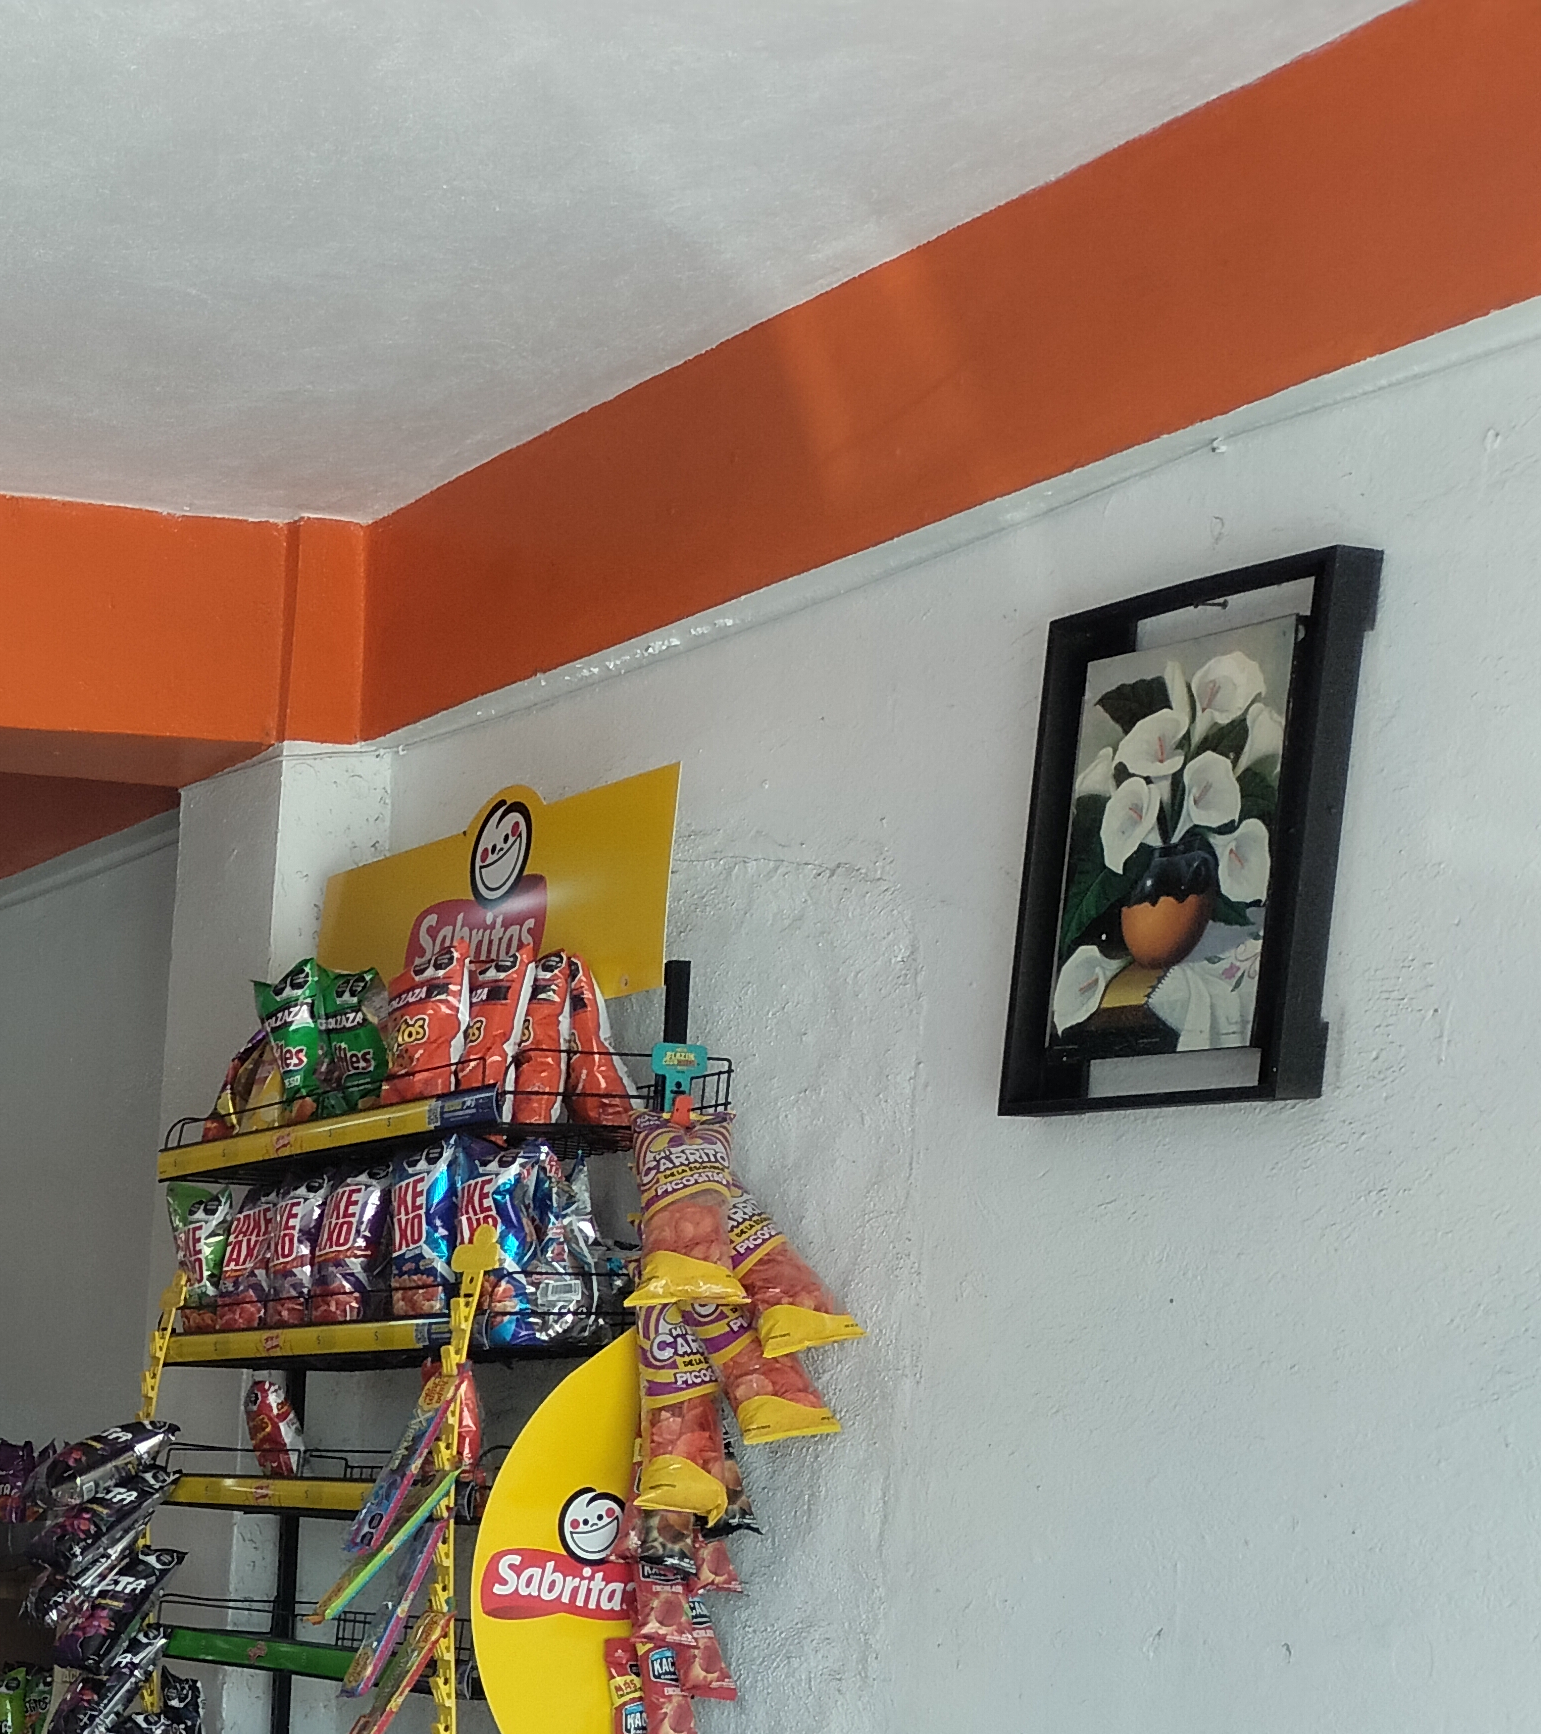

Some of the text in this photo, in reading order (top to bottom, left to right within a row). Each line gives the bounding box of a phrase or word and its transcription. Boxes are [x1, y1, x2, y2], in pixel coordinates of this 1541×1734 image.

[416, 911, 535, 960] Sabritas
[641, 1149, 730, 1186] CARRITO
[657, 1172, 728, 1196] PICOSITAS
